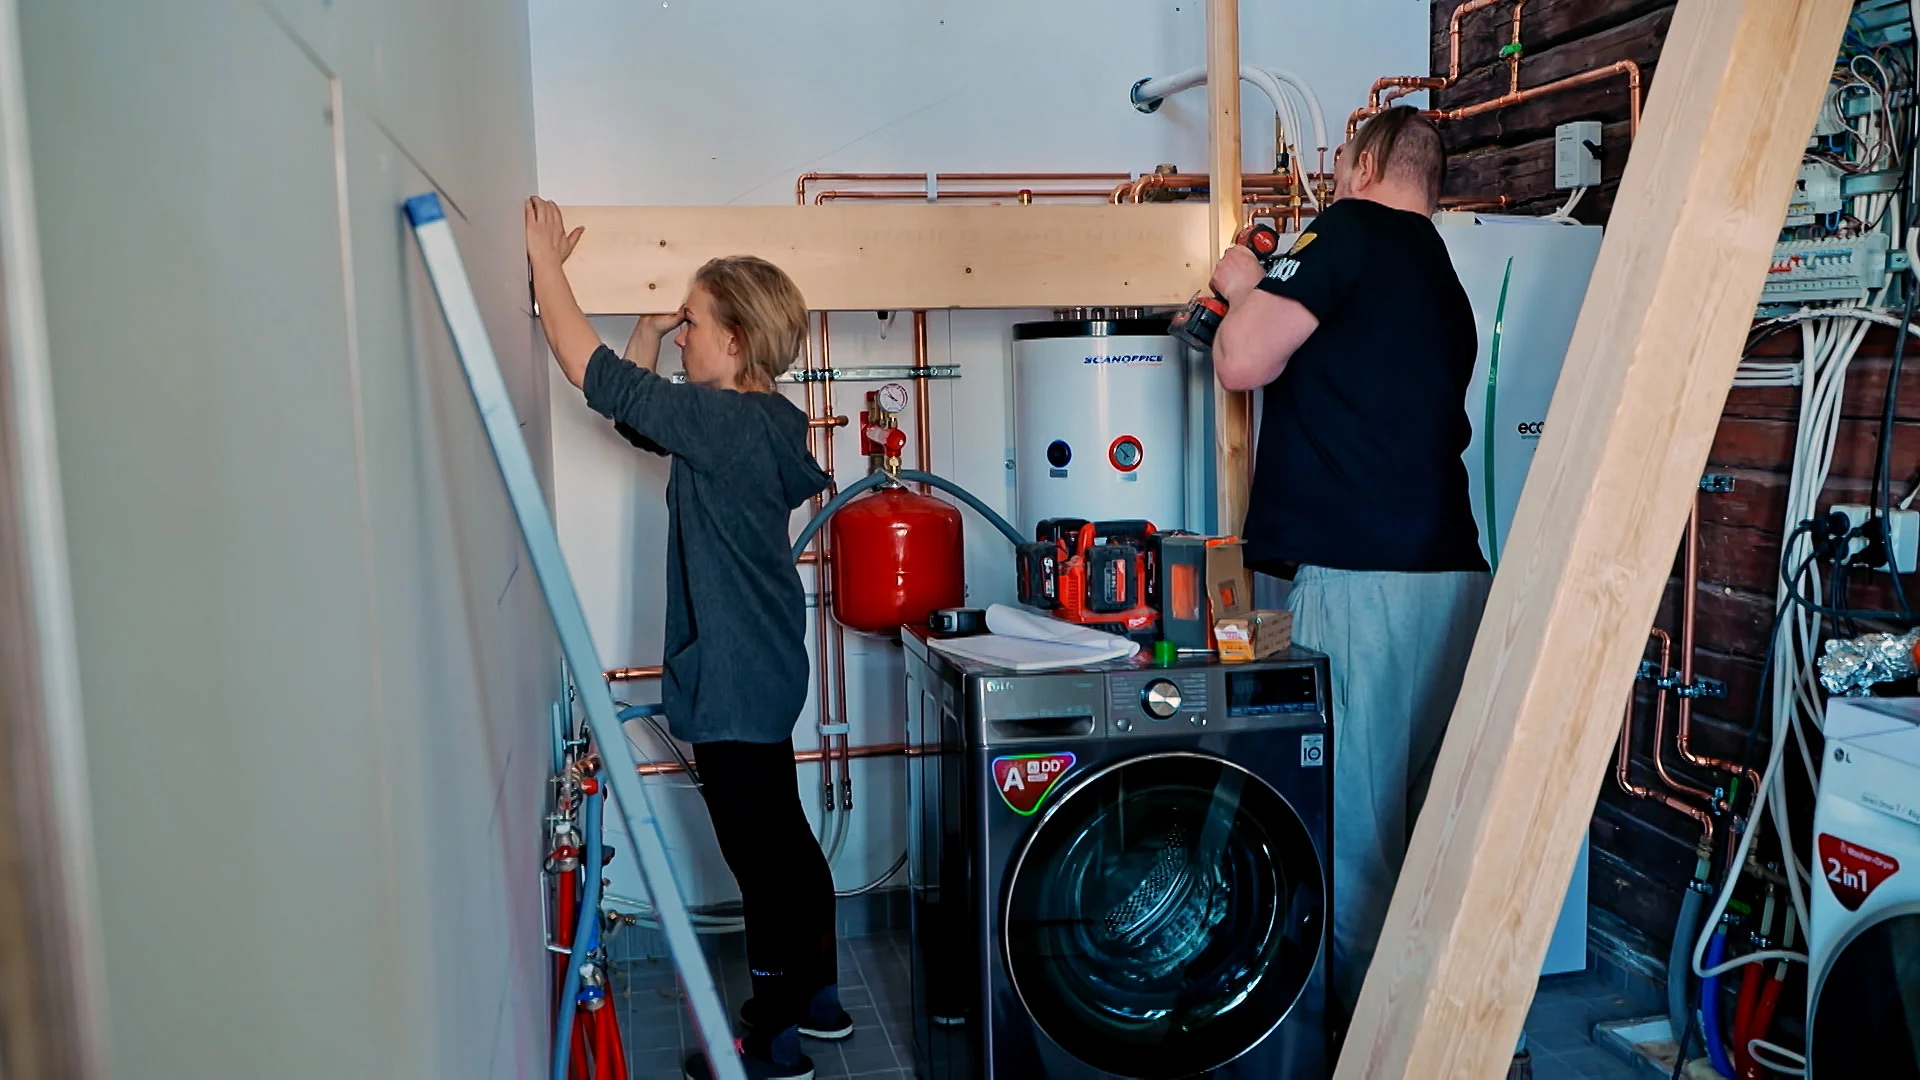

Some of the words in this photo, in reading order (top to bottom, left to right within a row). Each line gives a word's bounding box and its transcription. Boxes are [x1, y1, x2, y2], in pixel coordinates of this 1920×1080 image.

[1083, 354, 1163, 364] SCANOFFICE
[1003, 767, 1025, 792] A
[1827, 857, 1868, 893] 2in1
